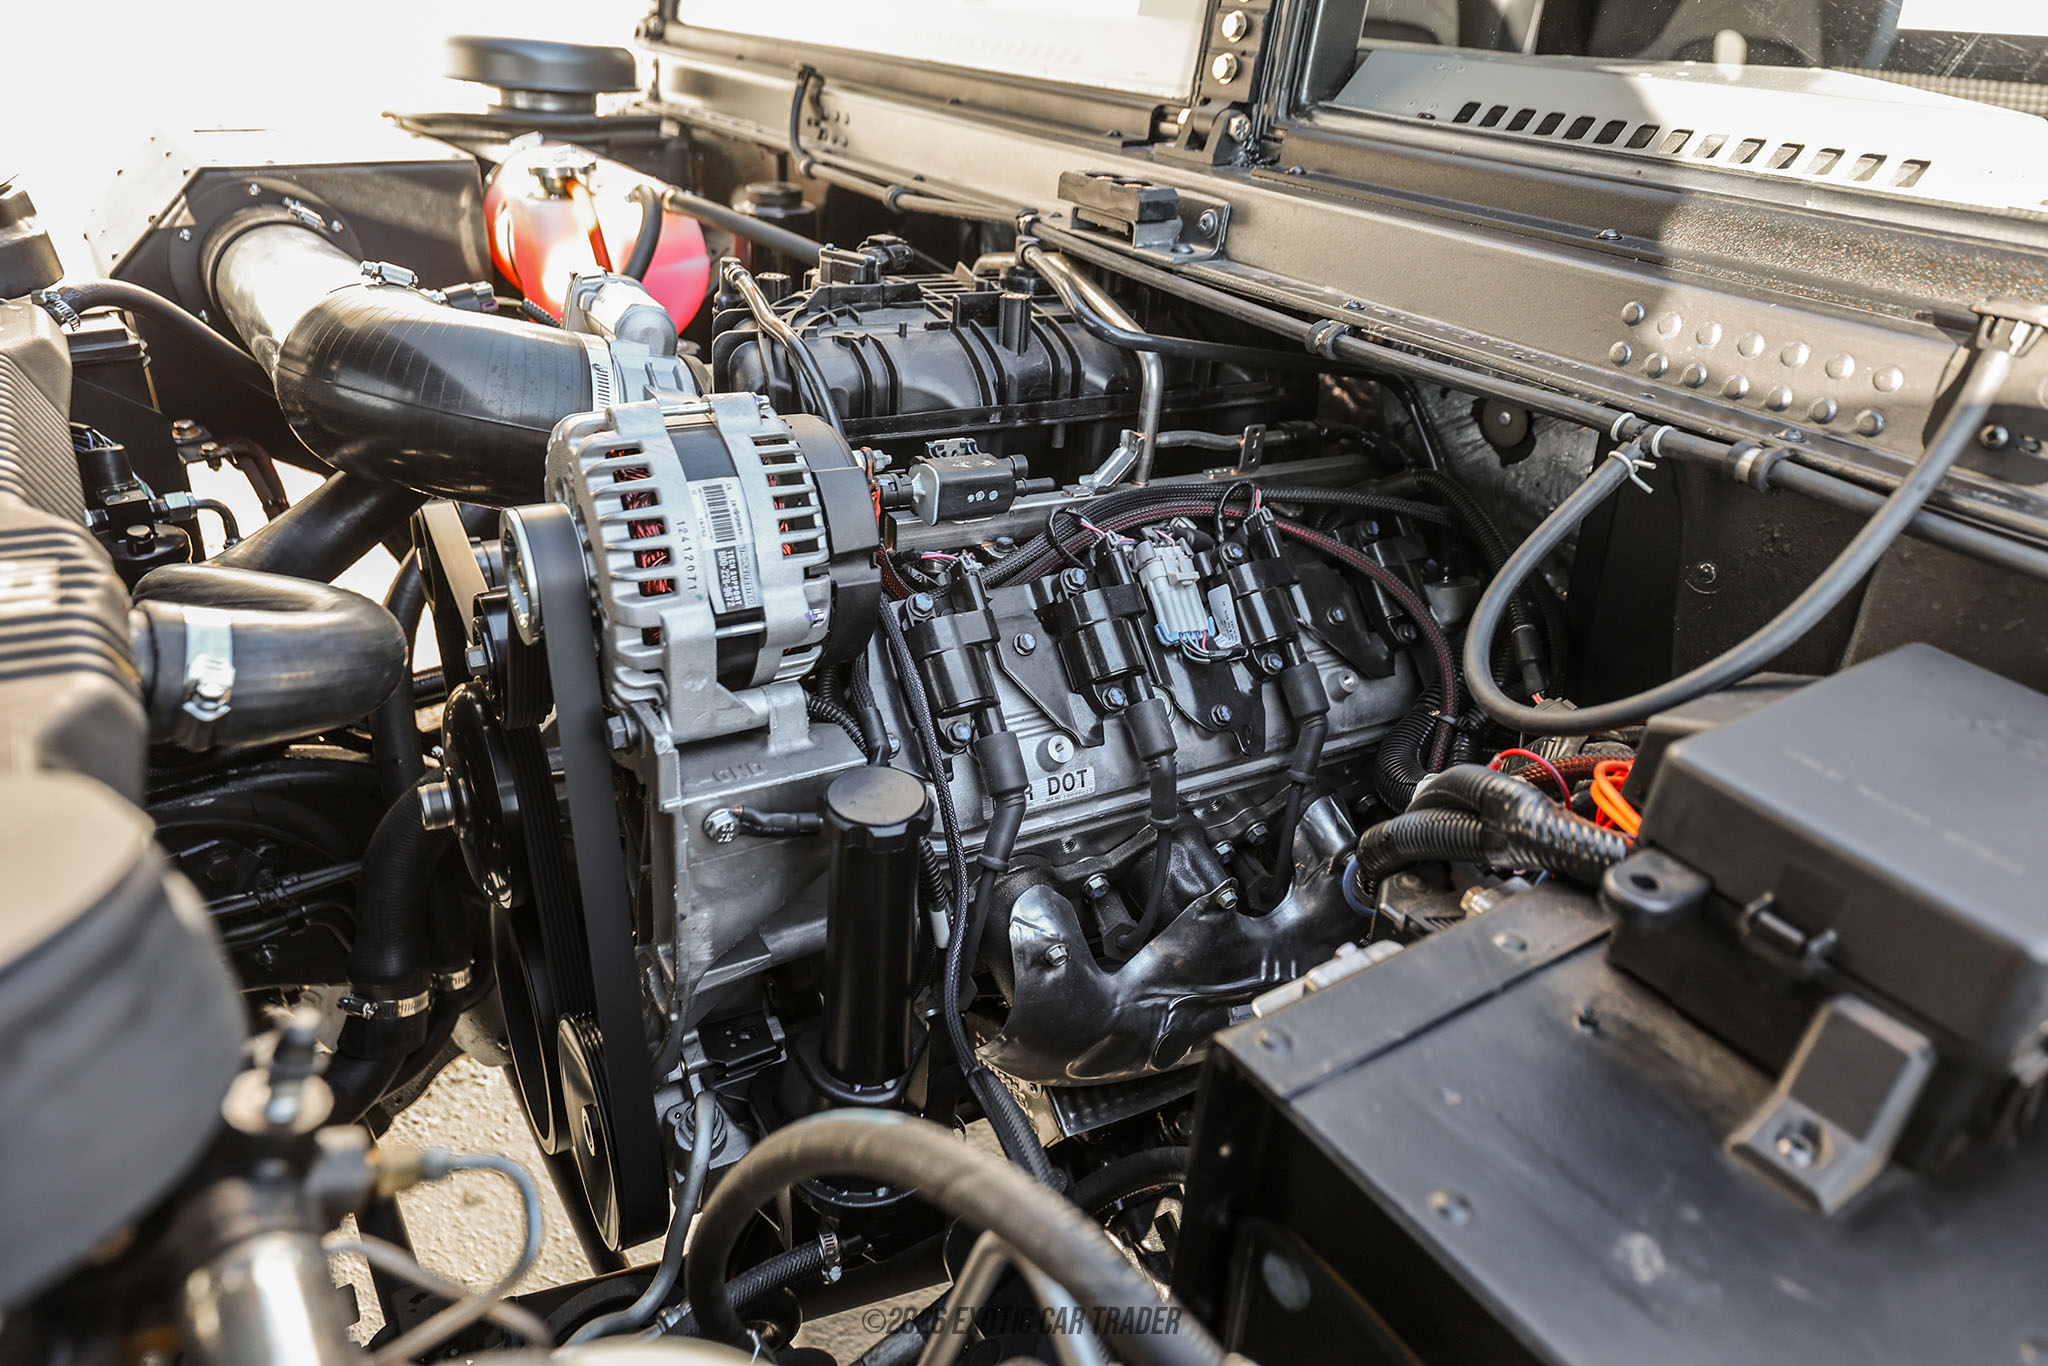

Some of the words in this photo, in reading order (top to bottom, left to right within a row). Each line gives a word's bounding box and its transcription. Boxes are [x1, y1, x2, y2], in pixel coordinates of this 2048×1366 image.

[676, 521, 697, 590] 12412071
[726, 550, 736, 568] TECH
[731, 571, 742, 605] SUPPORT
[1047, 769, 1088, 796] DOT
